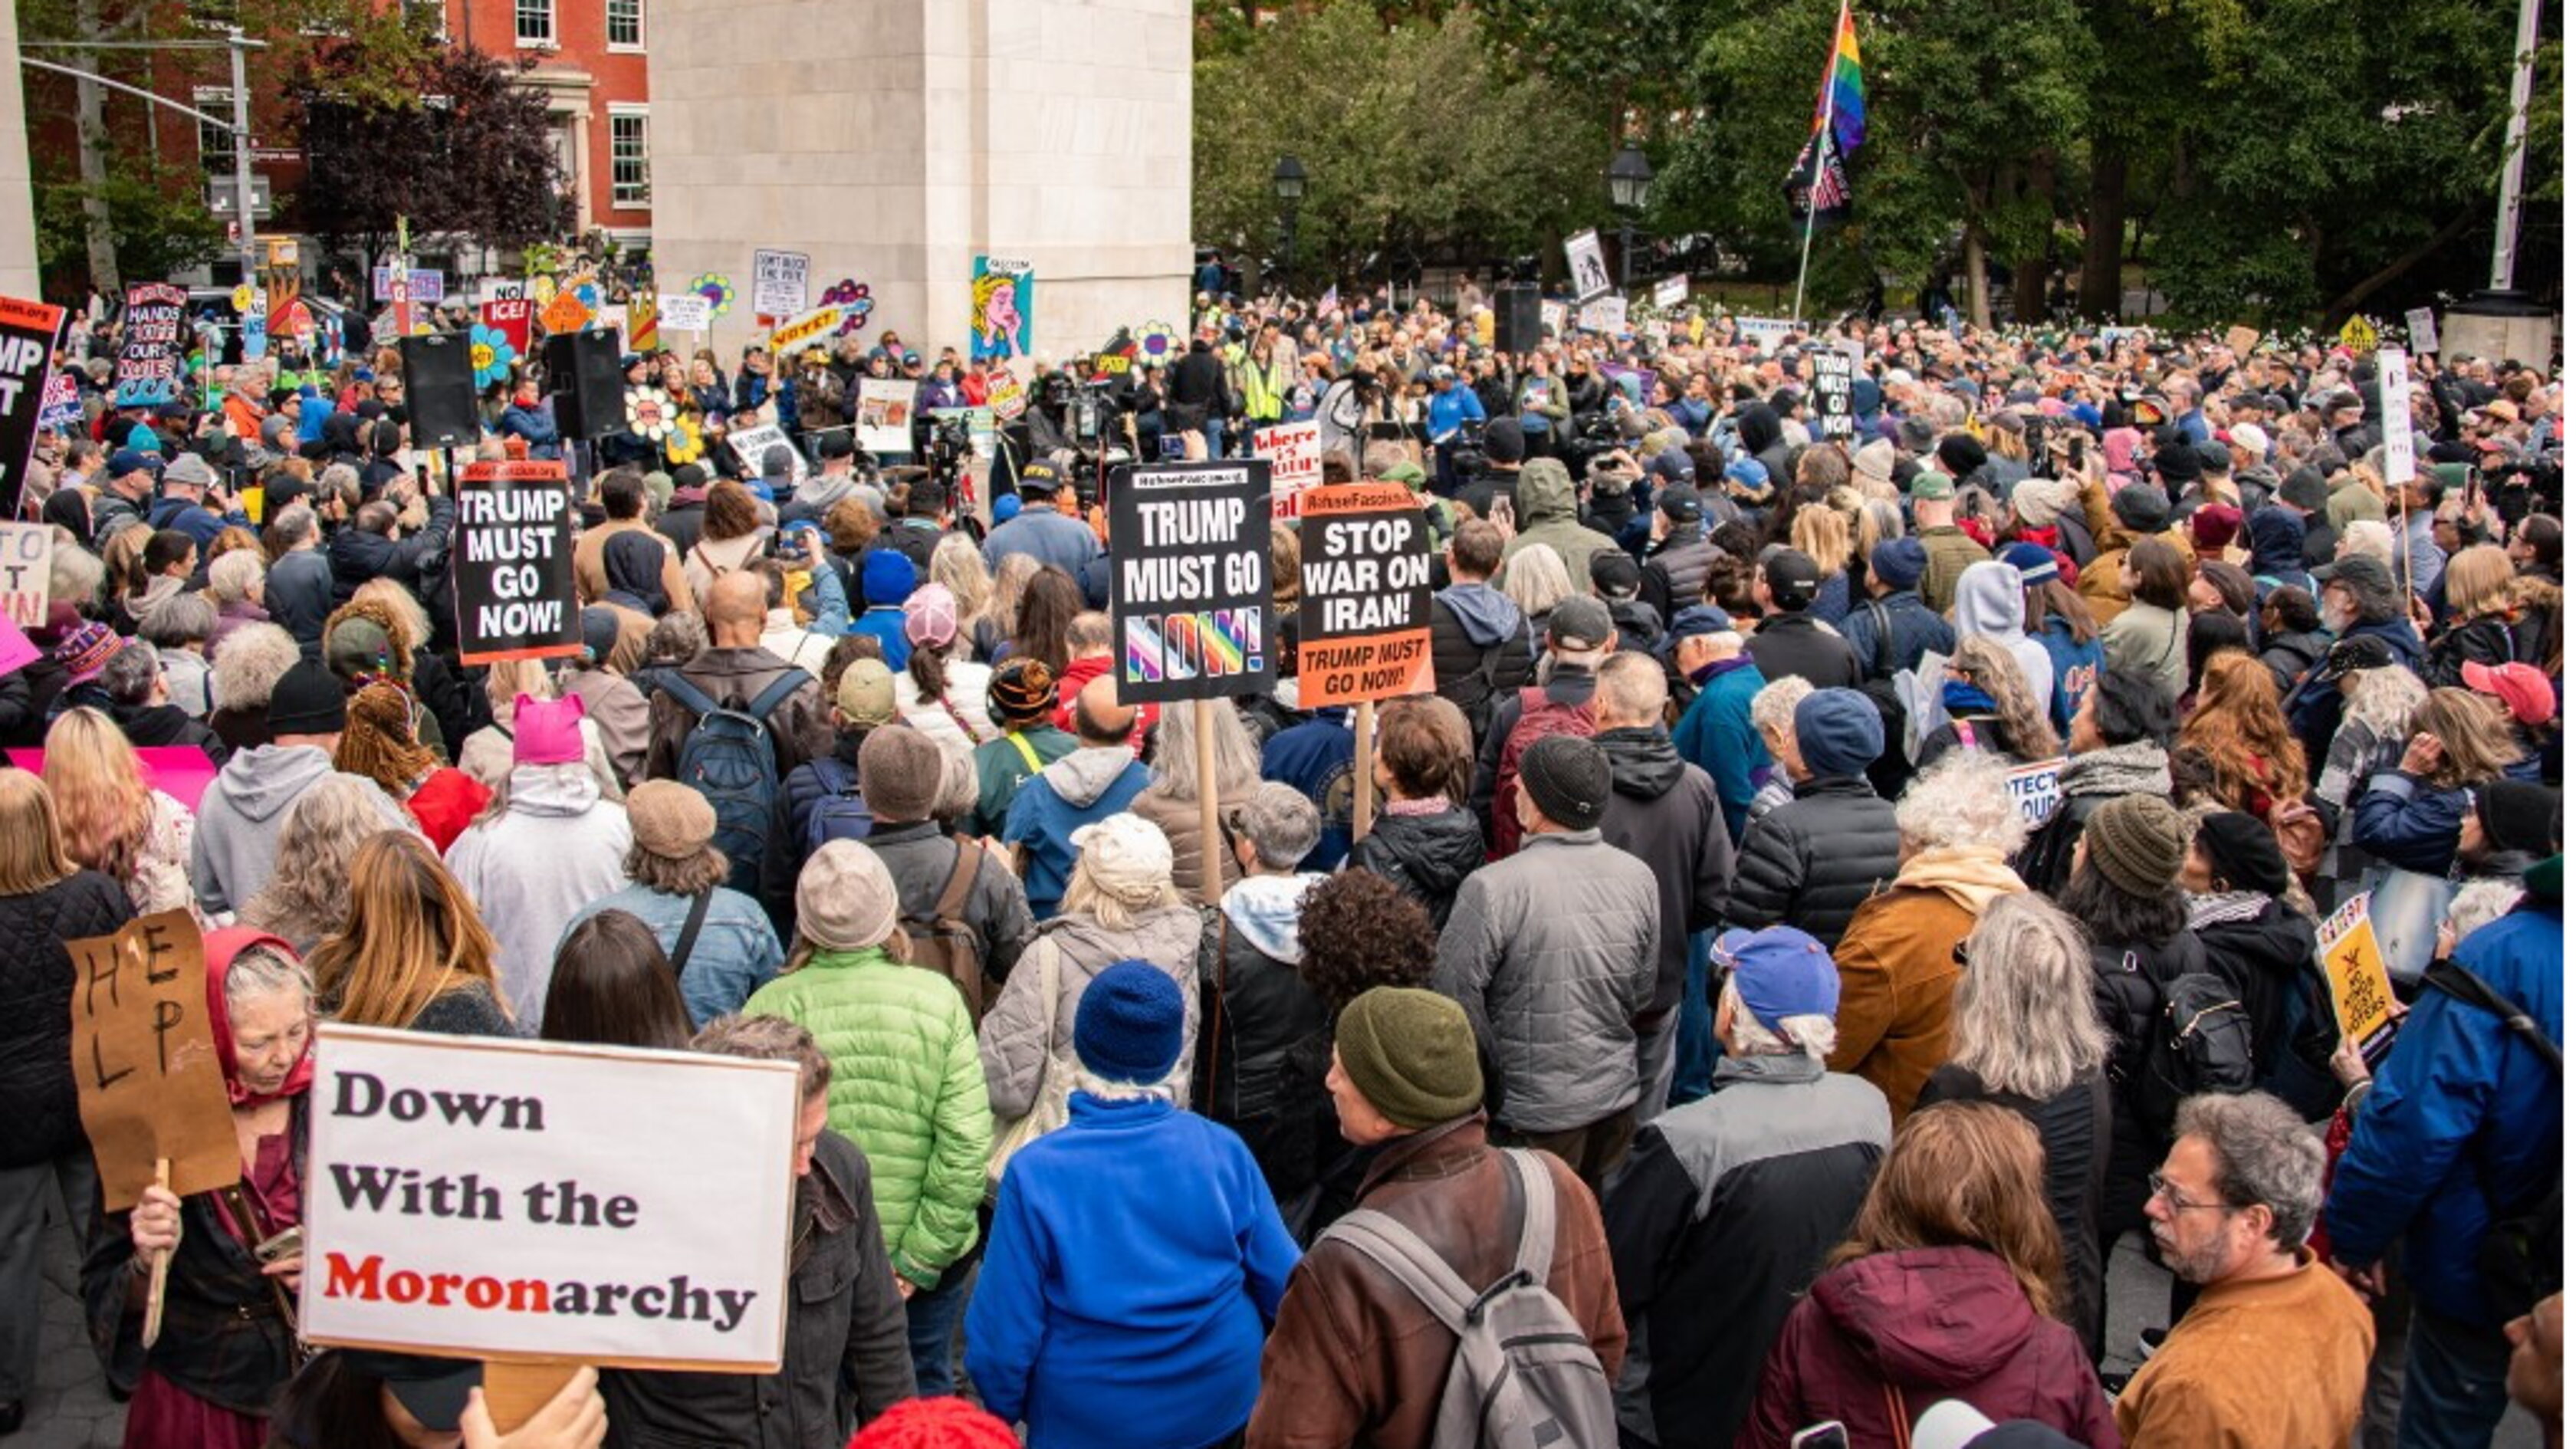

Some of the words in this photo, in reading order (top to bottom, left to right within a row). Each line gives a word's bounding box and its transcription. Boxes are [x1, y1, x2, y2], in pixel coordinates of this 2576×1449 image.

[492, 302, 526, 321] ICE!
[461, 490, 564, 524] TRUMP
[1137, 498, 1246, 547] TRUMP
[468, 527, 557, 562] MUST
[1325, 518, 1412, 557] STOP
[492, 564, 540, 599] GO
[1124, 555, 1216, 603] MUST
[1225, 550, 1262, 596] GO
[1303, 560, 1379, 597] WAR
[1388, 553, 1430, 590] ON
[478, 601, 562, 639] NOW!
[1323, 592, 1411, 632] IRAN!
[1125, 606, 1263, 683] NOW!
[1305, 646, 1375, 672] TRUMP
[1378, 639, 1425, 665] MUST
[1326, 675, 1354, 695] GO
[1361, 667, 1405, 692] NOW!
[332, 1071, 545, 1131] Down
[330, 1164, 502, 1221] With
[524, 1181, 639, 1228] the
[324, 1253, 757, 1333] Moronarchy
